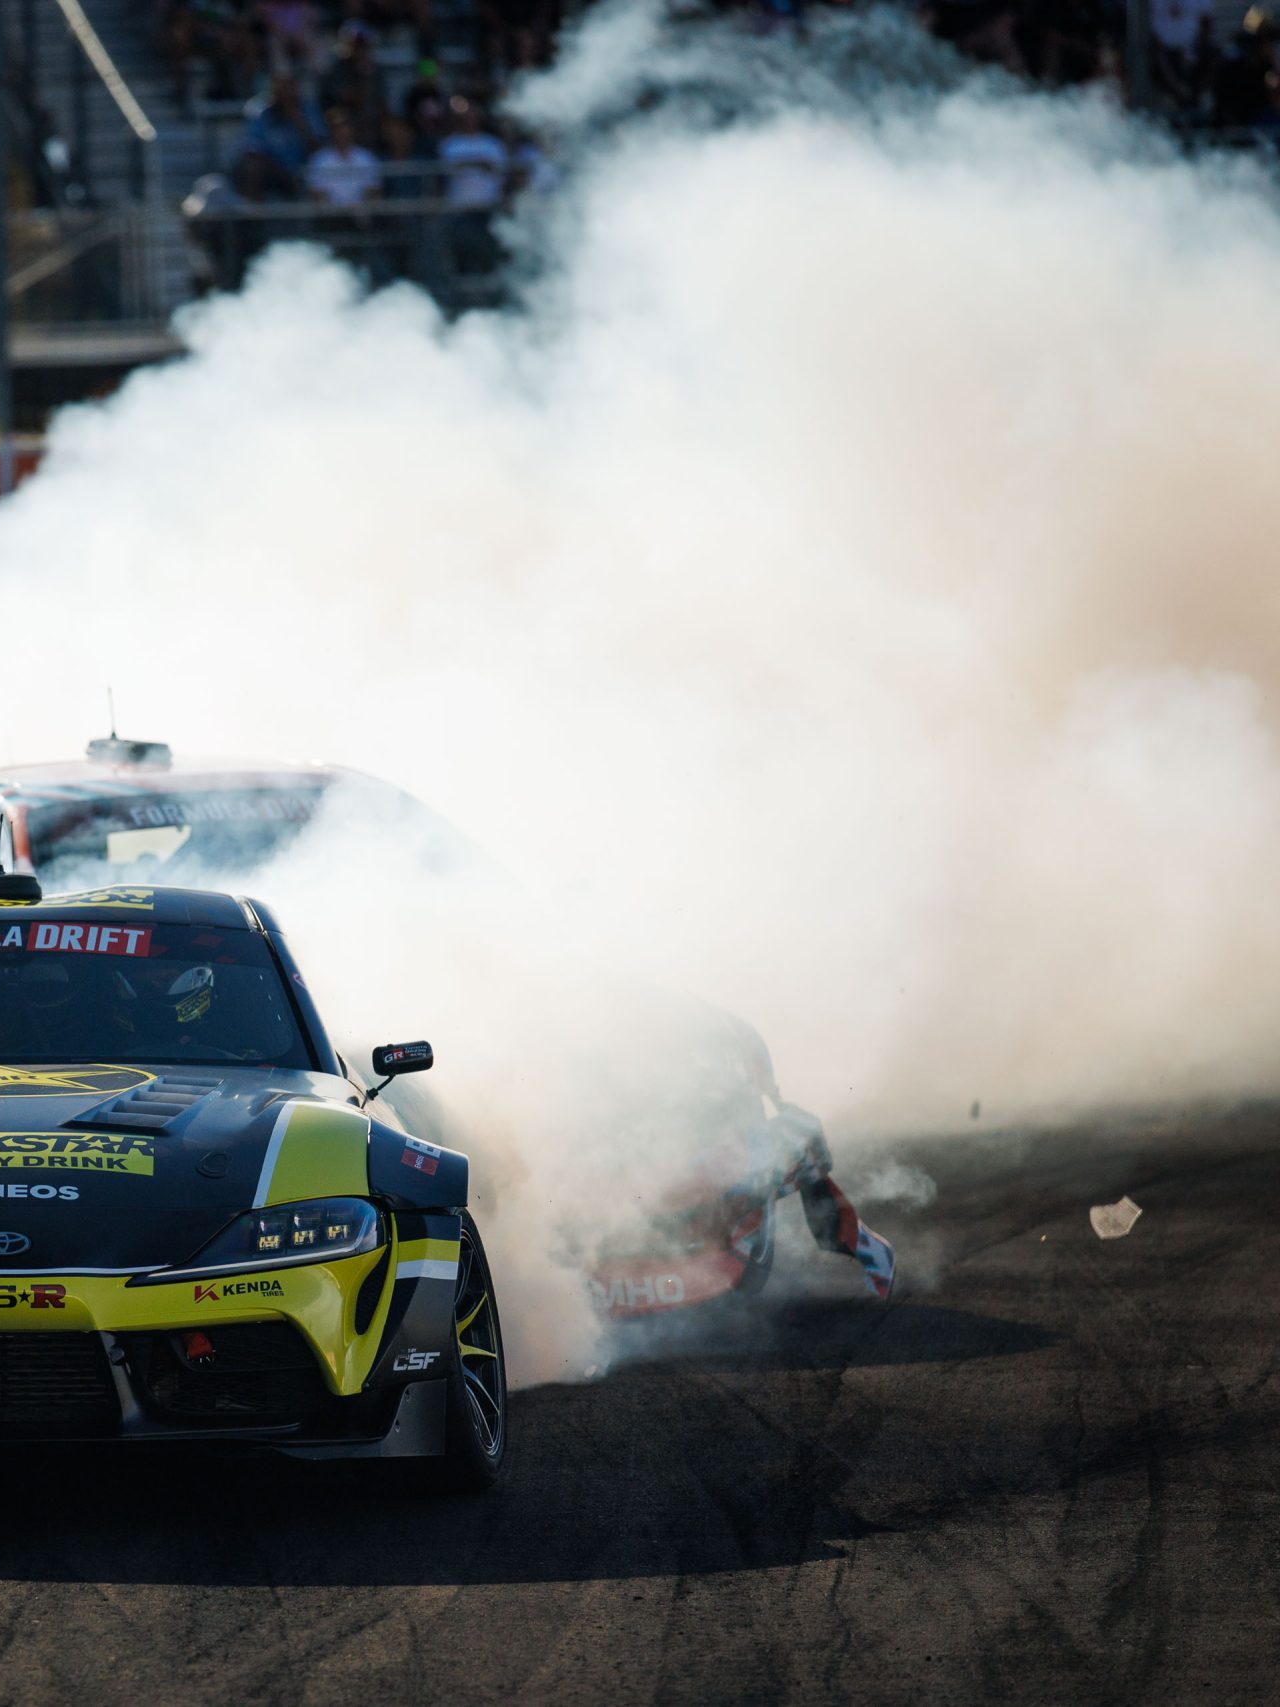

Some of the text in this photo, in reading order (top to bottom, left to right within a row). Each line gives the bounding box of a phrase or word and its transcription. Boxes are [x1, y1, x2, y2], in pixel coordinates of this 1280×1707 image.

[34, 923, 145, 954] DRIFT
[384, 1051, 404, 1063] GR
[23, 1155, 129, 1171] DRINK
[223, 1280, 283, 1297] KENDA
[261, 1289, 285, 1297] TIRES
[393, 1352, 440, 1371] CSF
